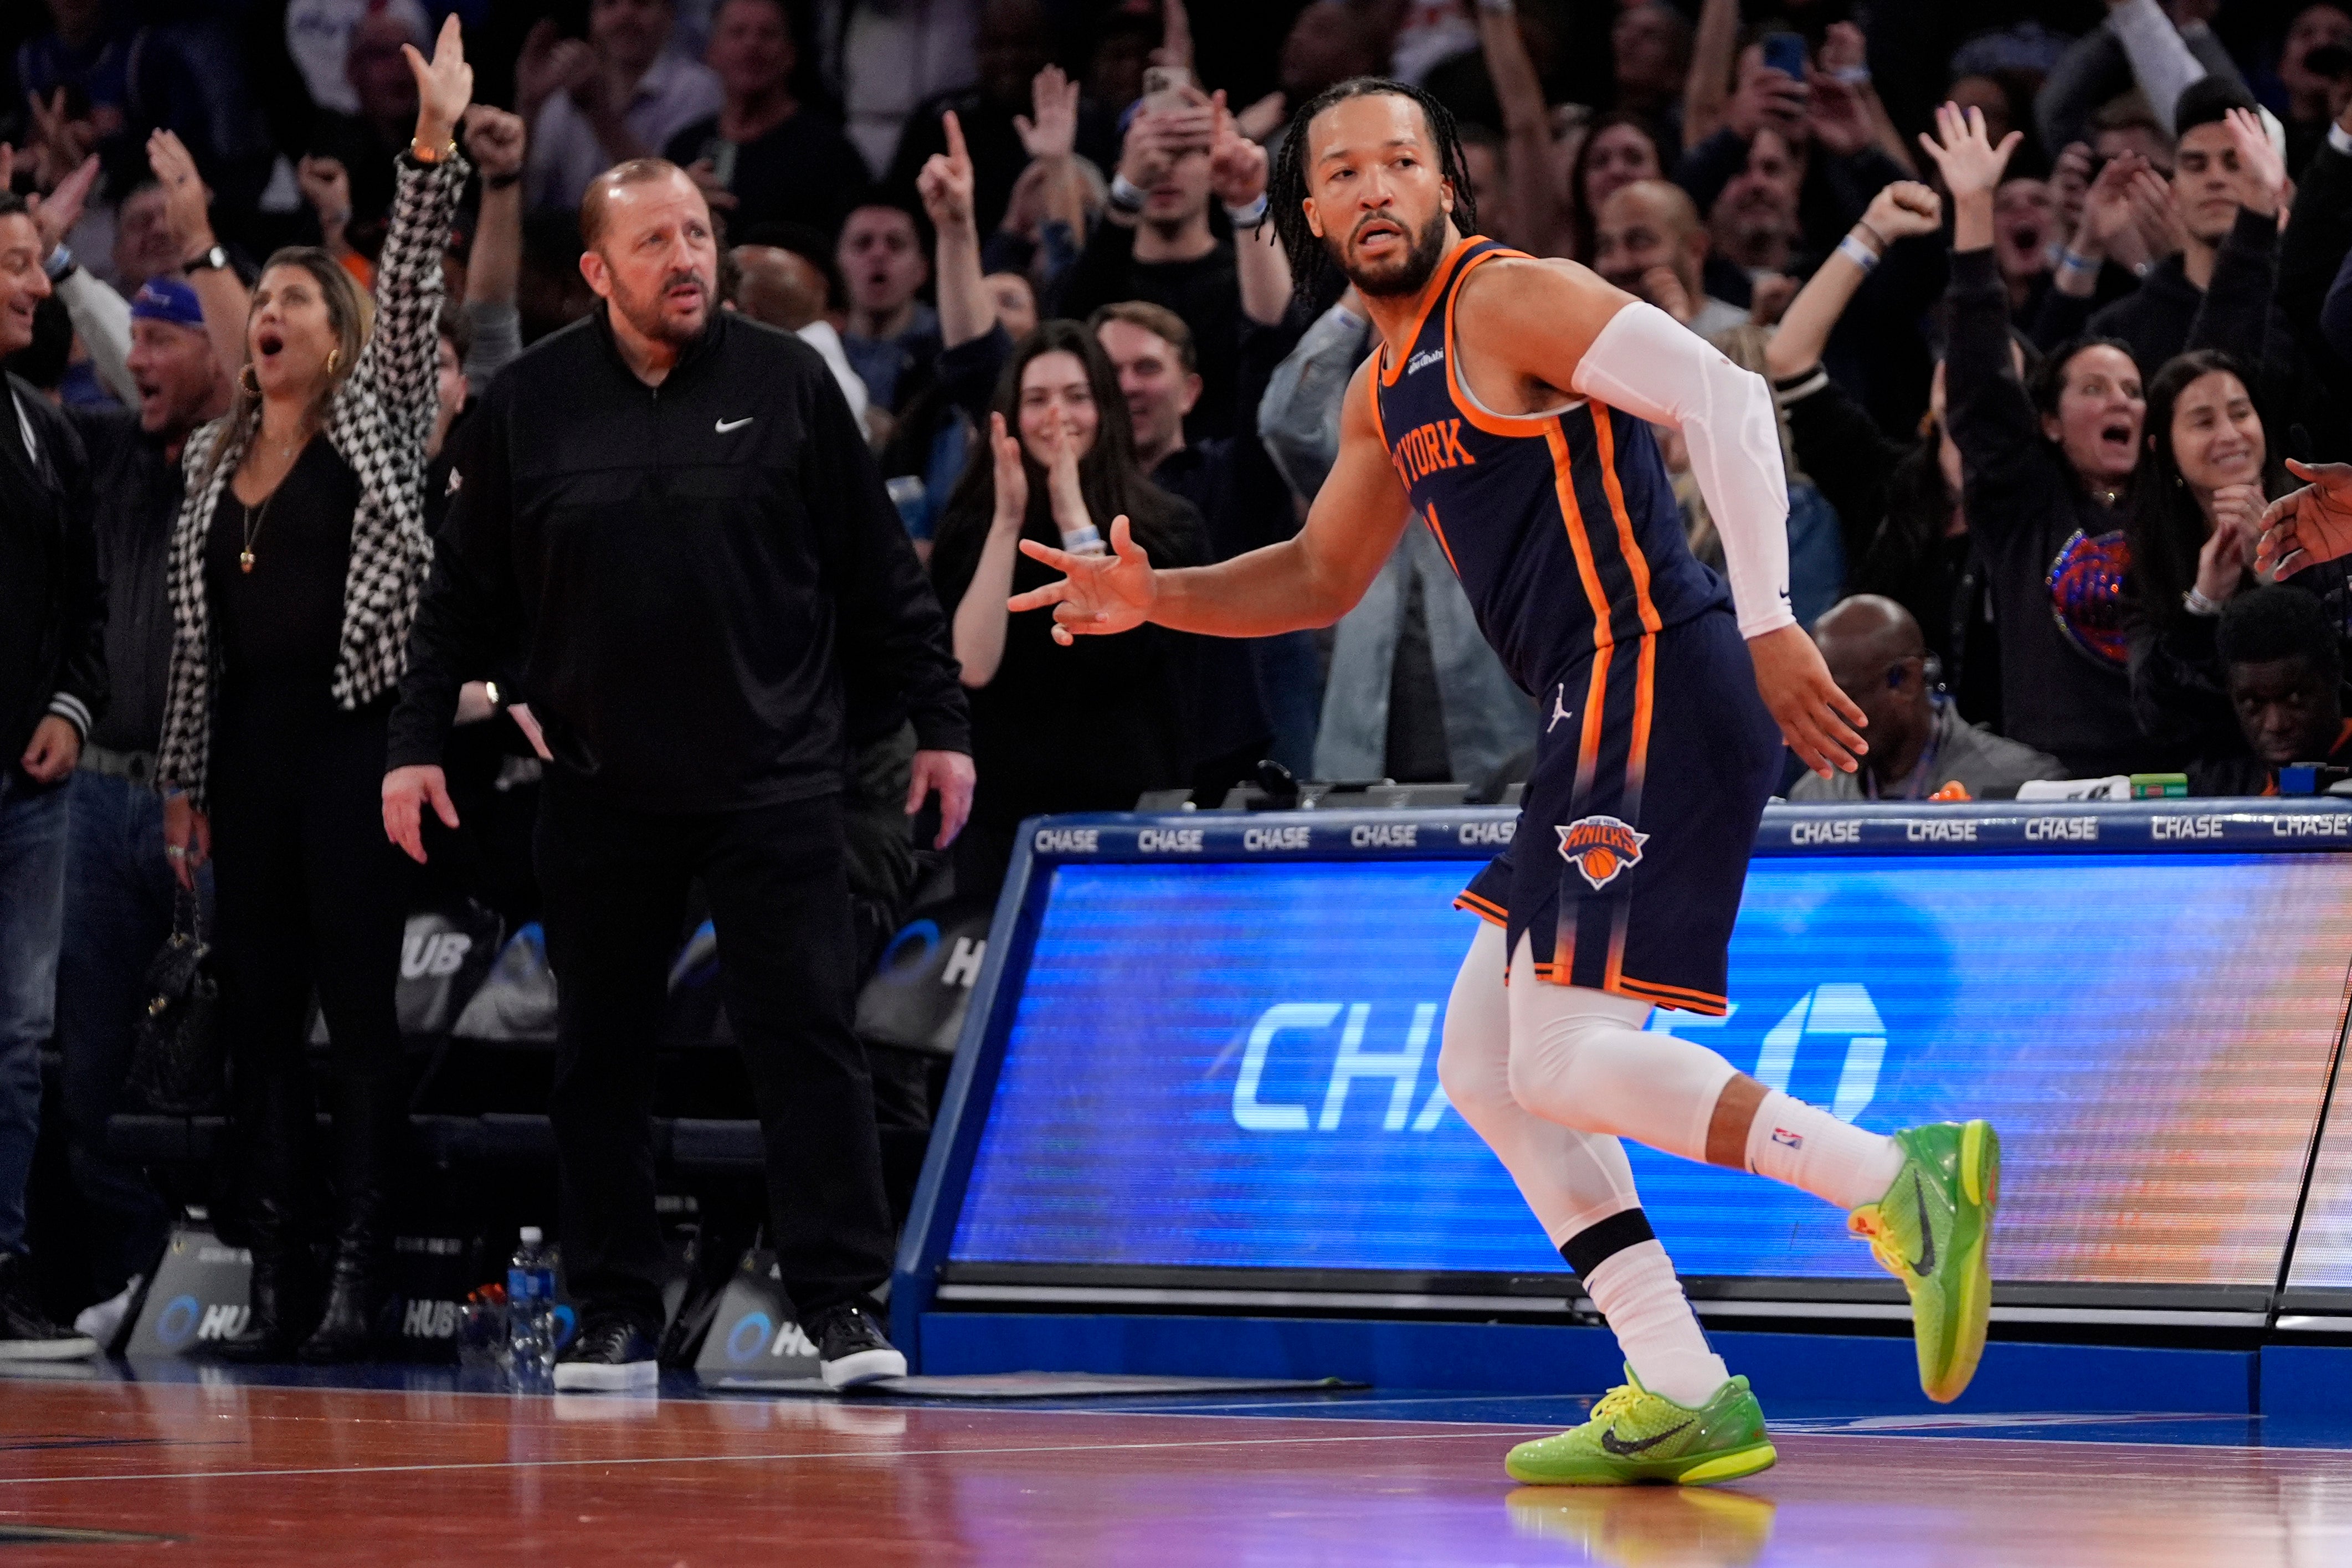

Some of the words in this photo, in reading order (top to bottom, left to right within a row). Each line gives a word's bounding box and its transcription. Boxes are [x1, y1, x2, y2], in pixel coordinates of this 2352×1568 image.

[1400, 418, 1476, 482] YORK
[1350, 824, 1417, 848] CHASE
[1459, 821, 1517, 845] CHAS
[1791, 820, 1862, 846] CHASE
[1907, 819, 1978, 841] CHASE
[2025, 816, 2098, 840] CHASE
[2151, 815, 2224, 840] CHASE
[2273, 814, 2349, 837] CHASE
[1035, 829, 1098, 853] CHASE
[1138, 830, 1203, 853] CHASE
[1244, 827, 1310, 851] CHASE
[1564, 824, 1639, 857] KNICKS
[401, 932, 471, 979] UB
[198, 1304, 251, 1340] HU
